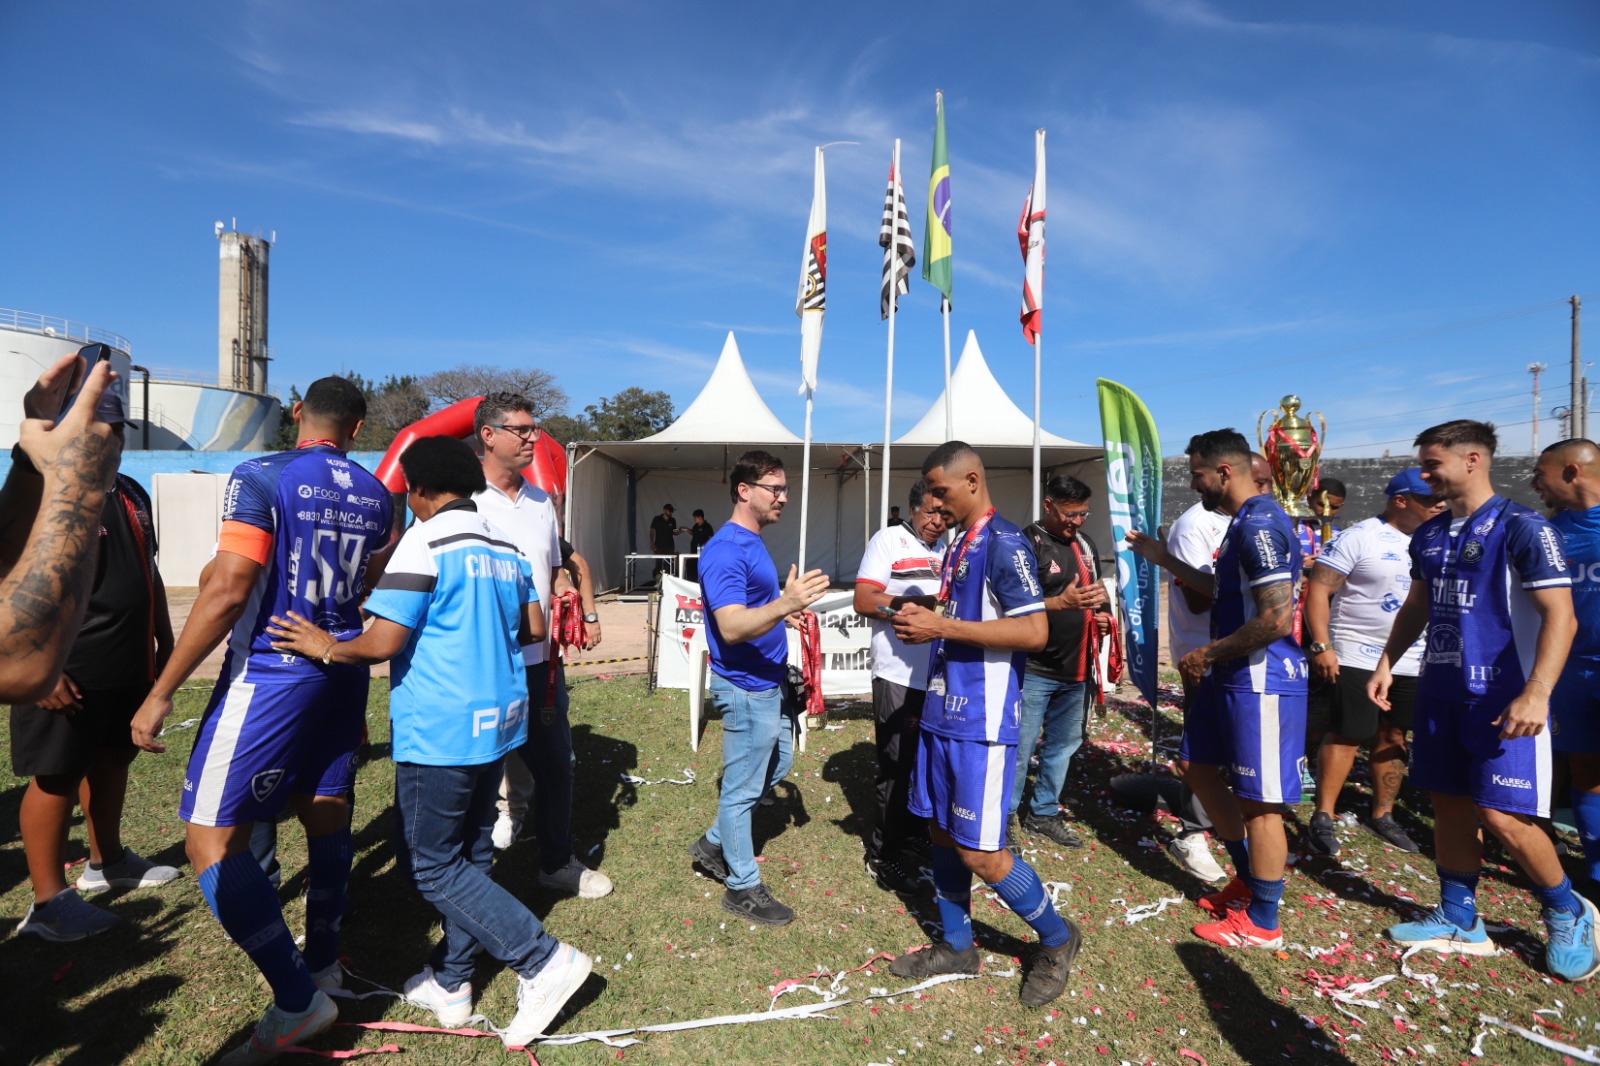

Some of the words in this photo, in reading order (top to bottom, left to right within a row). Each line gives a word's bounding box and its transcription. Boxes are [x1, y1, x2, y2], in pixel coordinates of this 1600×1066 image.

[325, 508, 363, 524] BANCA
[1253, 535, 1266, 568] PIZZARIA
[1538, 531, 1555, 567] PIZZARIA
[287, 549, 300, 598] ALEX
[304, 529, 367, 606] 59
[1012, 555, 1029, 592] PIZZARIA
[1469, 665, 1501, 681] HP
[944, 694, 968, 712] HP
[1492, 774, 1532, 788] KARECA
